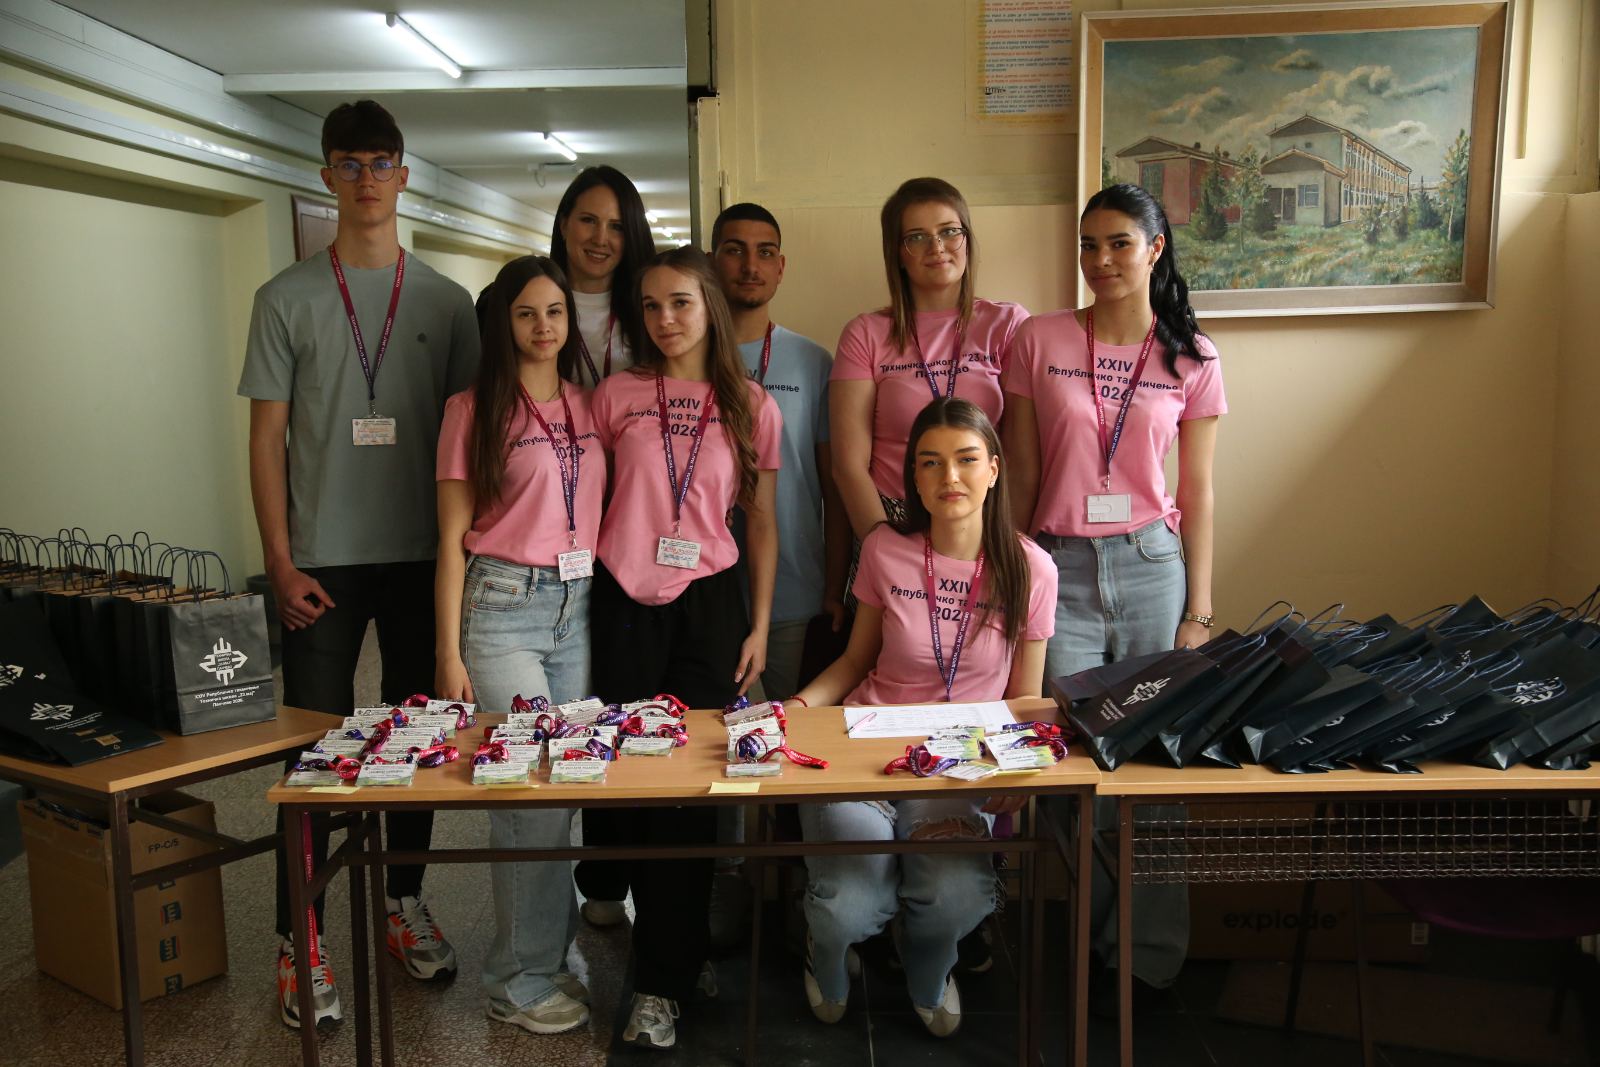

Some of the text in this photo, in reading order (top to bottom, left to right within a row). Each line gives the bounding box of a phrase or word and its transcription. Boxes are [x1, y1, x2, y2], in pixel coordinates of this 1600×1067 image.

[880, 361, 925, 374] Техничка
[915, 366, 969, 378] Пнчво
[1097, 357, 1133, 373] XXIV
[764, 384, 799, 392] мичење
[1117, 376, 1178, 390] тамичење
[1091, 384, 1130, 401] 026
[667, 398, 700, 409] XXIV
[661, 423, 698, 437] 026
[939, 578, 972, 594] XXIV
[891, 586, 954, 604] Републчко
[937, 607, 961, 621] 202
[148, 838, 179, 854] FP-C/5
[1223, 909, 1337, 932] explode
